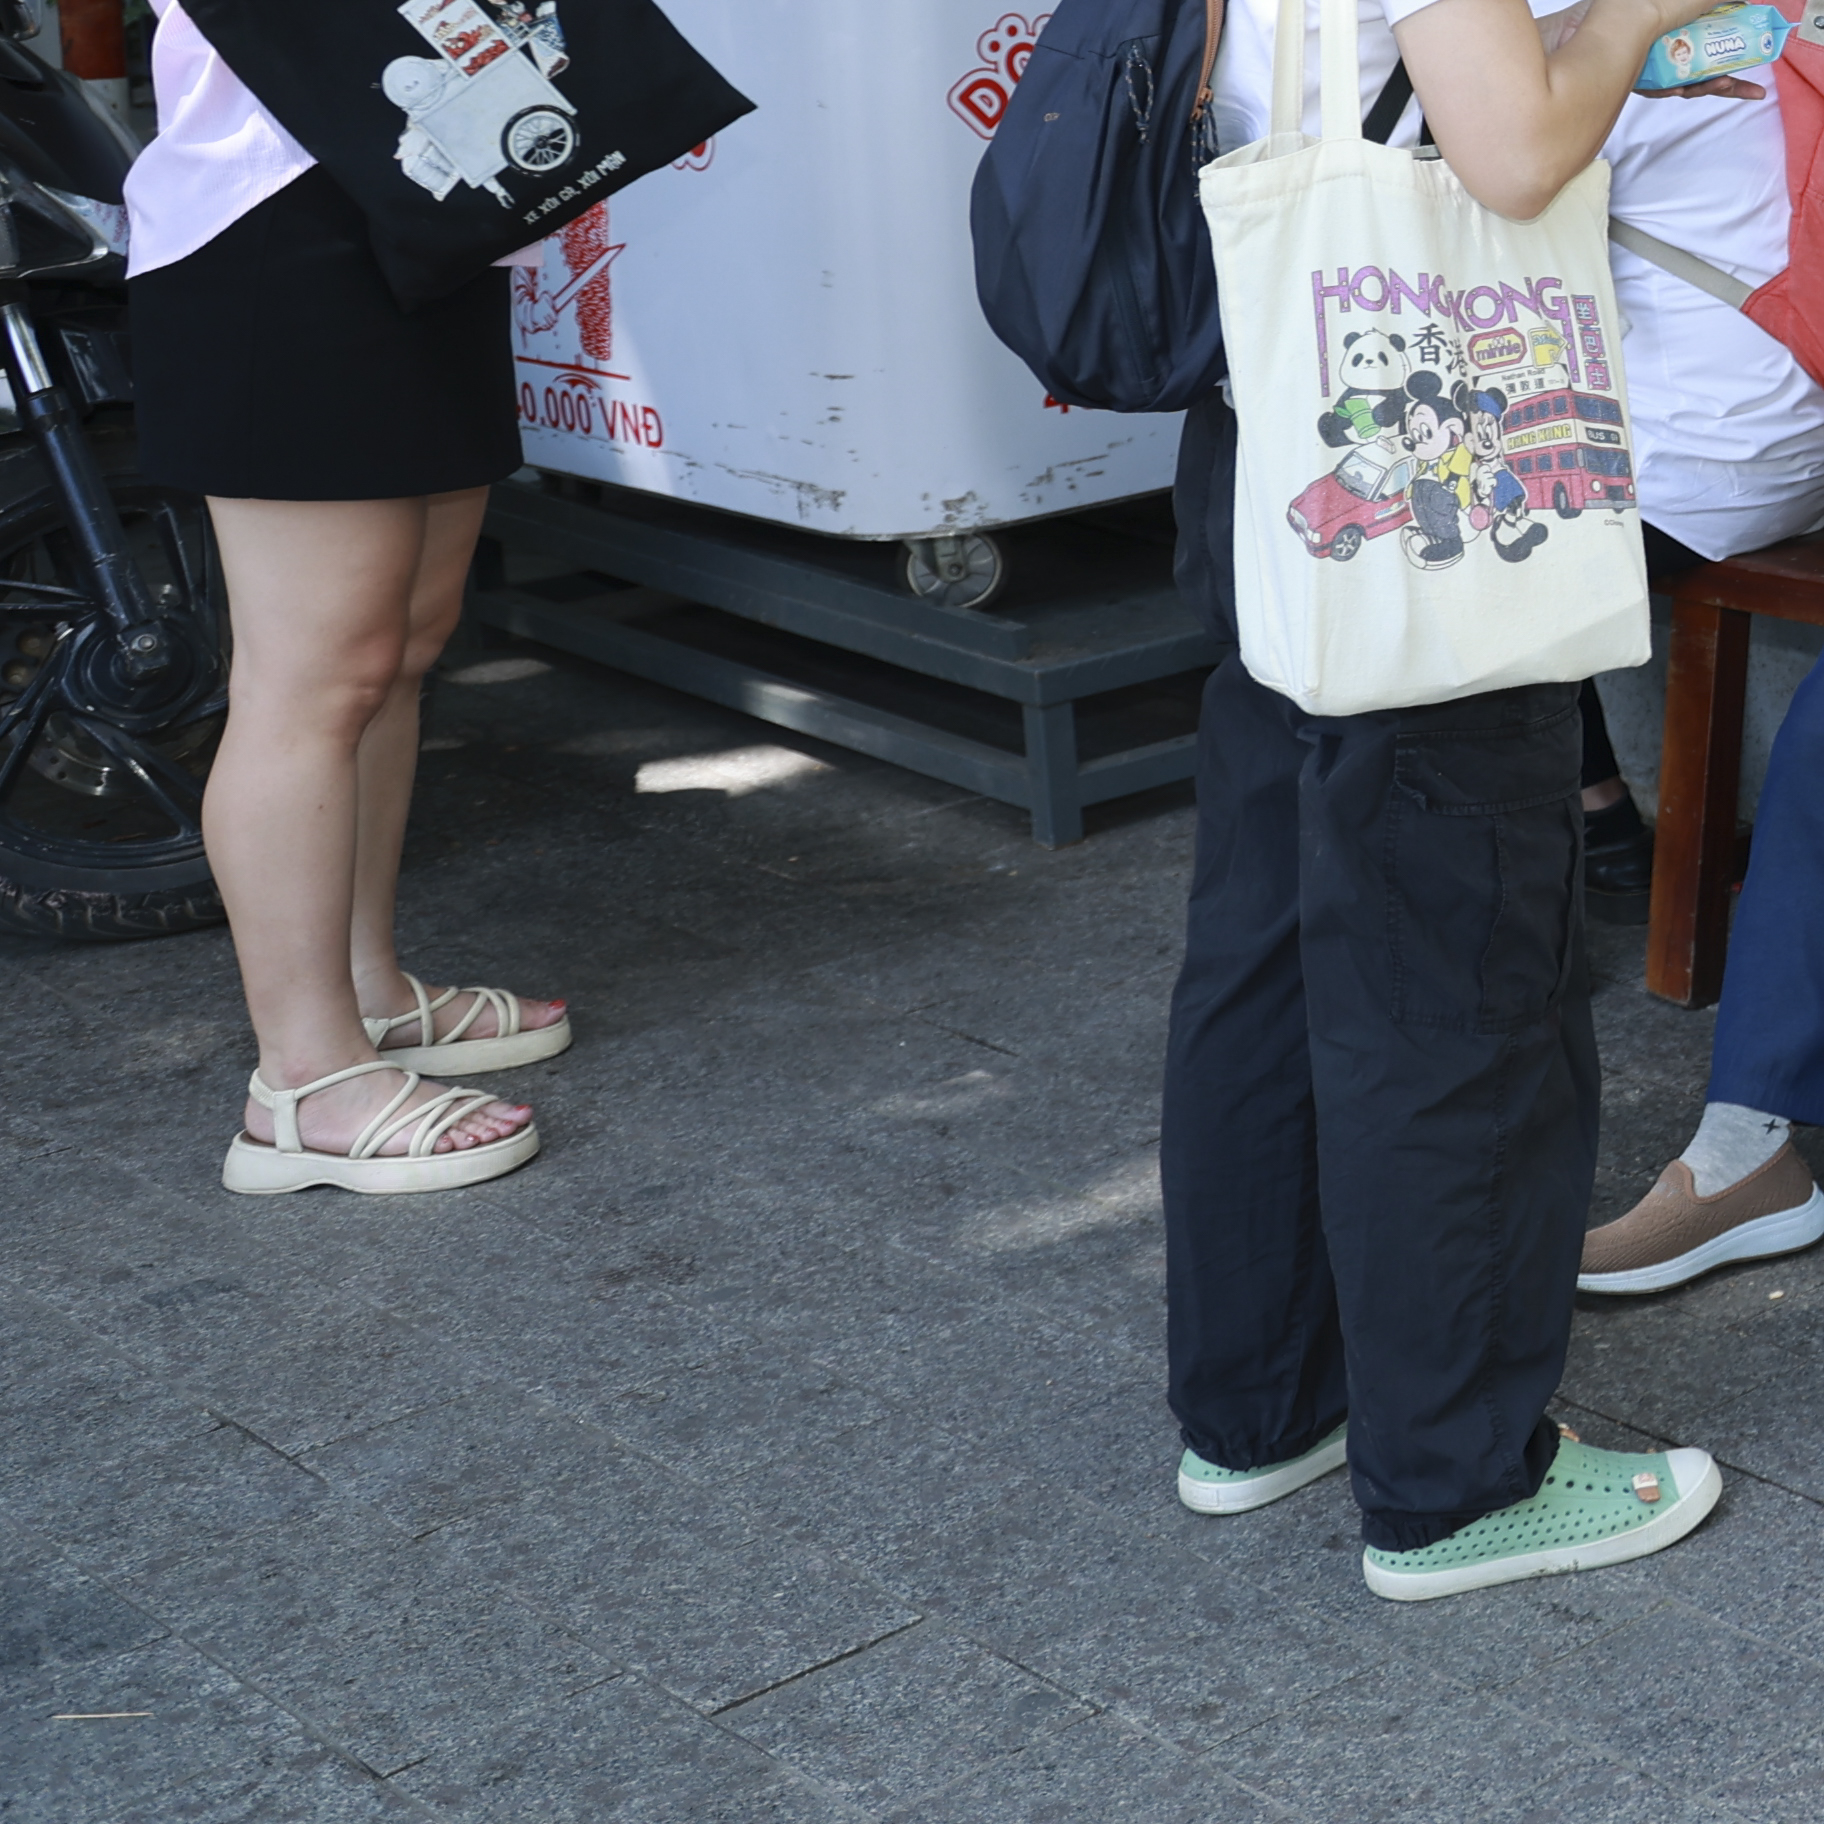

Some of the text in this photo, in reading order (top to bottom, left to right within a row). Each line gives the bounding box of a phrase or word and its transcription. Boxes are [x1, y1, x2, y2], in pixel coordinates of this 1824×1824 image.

[1704, 35, 1747, 58] NUNA
[1409, 322, 1468, 377] 香港
[1475, 339, 1521, 362] minnie
[516, 382, 664, 449] 0.000 VNĐ
